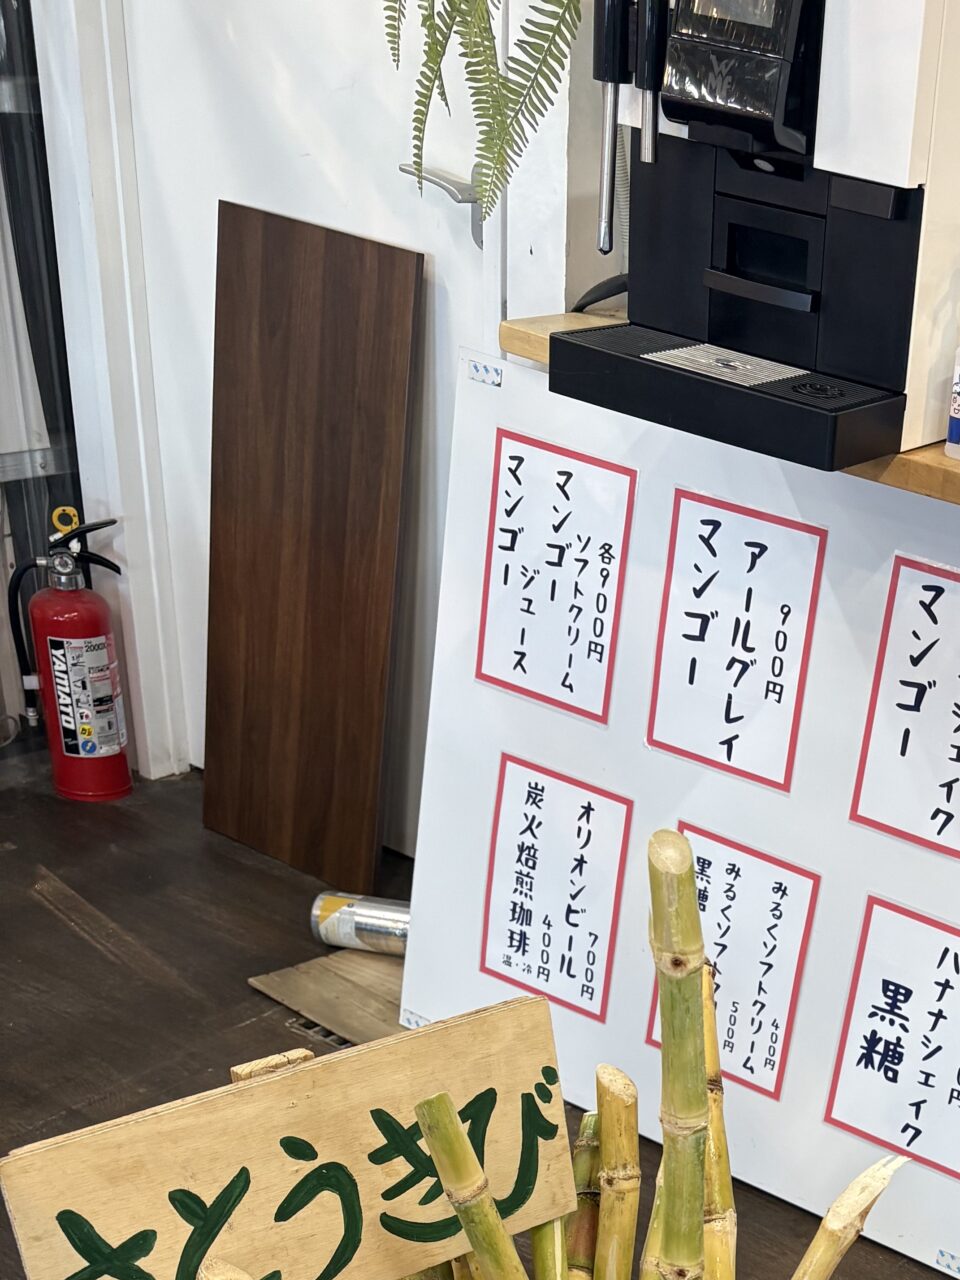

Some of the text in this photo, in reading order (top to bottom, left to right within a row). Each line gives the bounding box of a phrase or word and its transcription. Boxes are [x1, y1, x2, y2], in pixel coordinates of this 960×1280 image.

[498, 455, 524, 586] マンゴー
[544, 470, 574, 602] マンゴー
[512, 564, 540, 675] ジュース
[560, 533, 592, 694] ソフトクリーム
[587, 542, 616, 663] 各900円
[681, 518, 723, 686] マンゴー
[718, 541, 769, 762] アールグレイ
[763, 603, 793, 704] 900円
[51, 648, 76, 731] YAMATO
[895, 583, 946, 758] マンゴー
[507, 781, 546, 957] 炭火焙煎珈琲
[559, 800, 596, 980] オリオンビール
[536, 913, 553, 983] 400円
[580, 931, 599, 1002] 700円
[742, 880, 790, 1075] みるくソフトクリーム
[722, 1001, 740, 1054] 500円
[763, 1017, 781, 1072] 400円
[855, 977, 914, 1084] 黒糖
